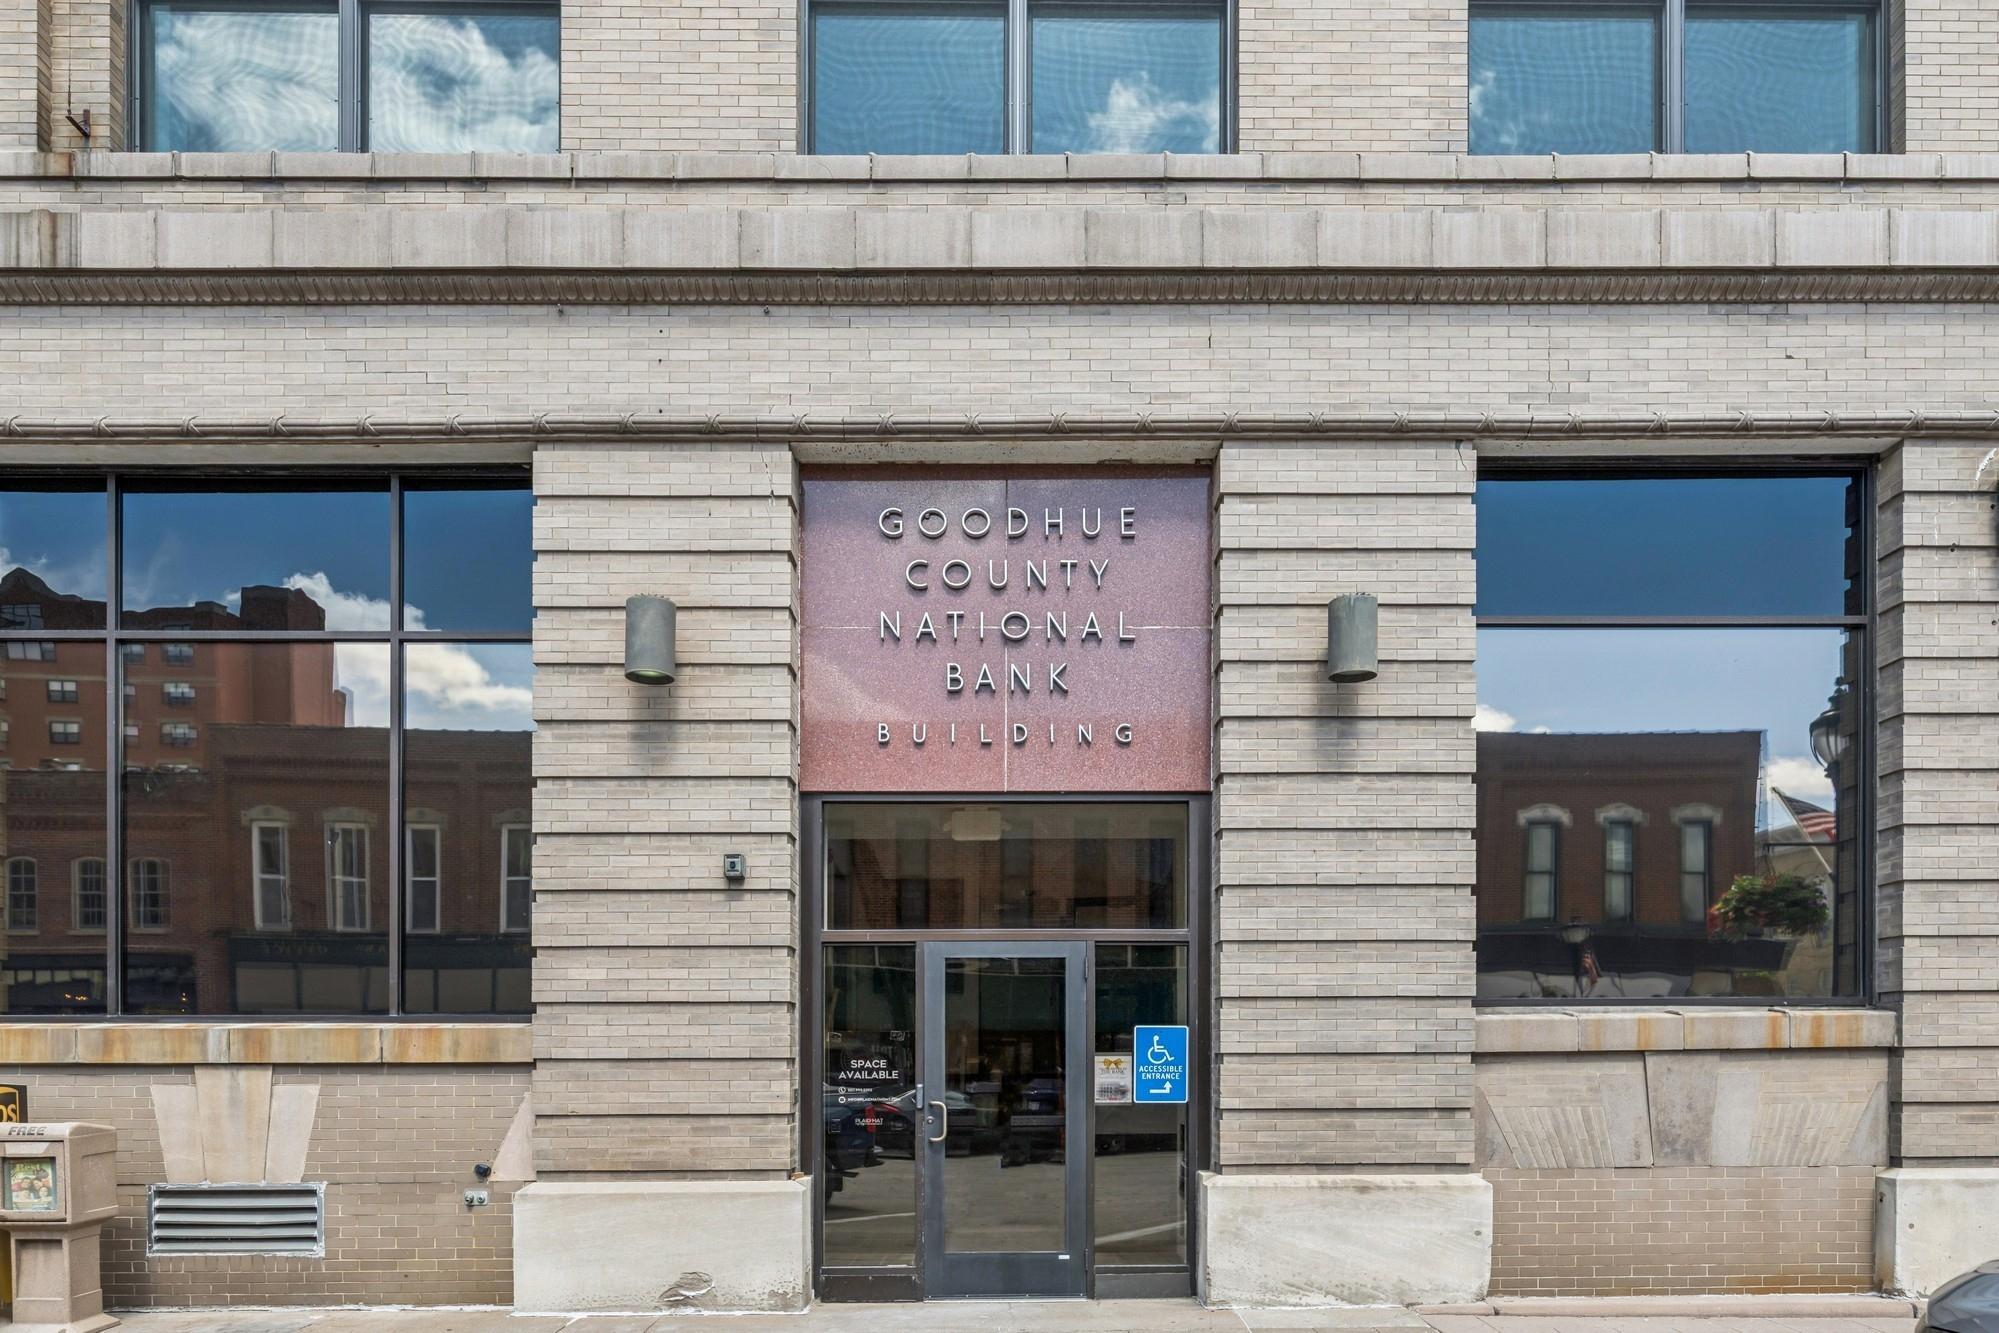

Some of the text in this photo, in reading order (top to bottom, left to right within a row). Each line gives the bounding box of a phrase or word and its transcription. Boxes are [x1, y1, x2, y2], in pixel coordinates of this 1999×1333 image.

[879, 507, 1136, 538] GOODHUE
[906, 559, 1109, 590] COUNTY
[880, 611, 1136, 641] NATIONAL
[946, 663, 1069, 693] BANK
[878, 723, 1133, 744] BUILDING
[850, 1059, 887, 1069] SPACE
[1139, 1065, 1183, 1073] ACCESSIBLE
[838, 1070, 899, 1079] AVAILABLE
[1142, 1072, 1180, 1080] ENTRANCE
[8, 1126, 47, 1136] FREE
